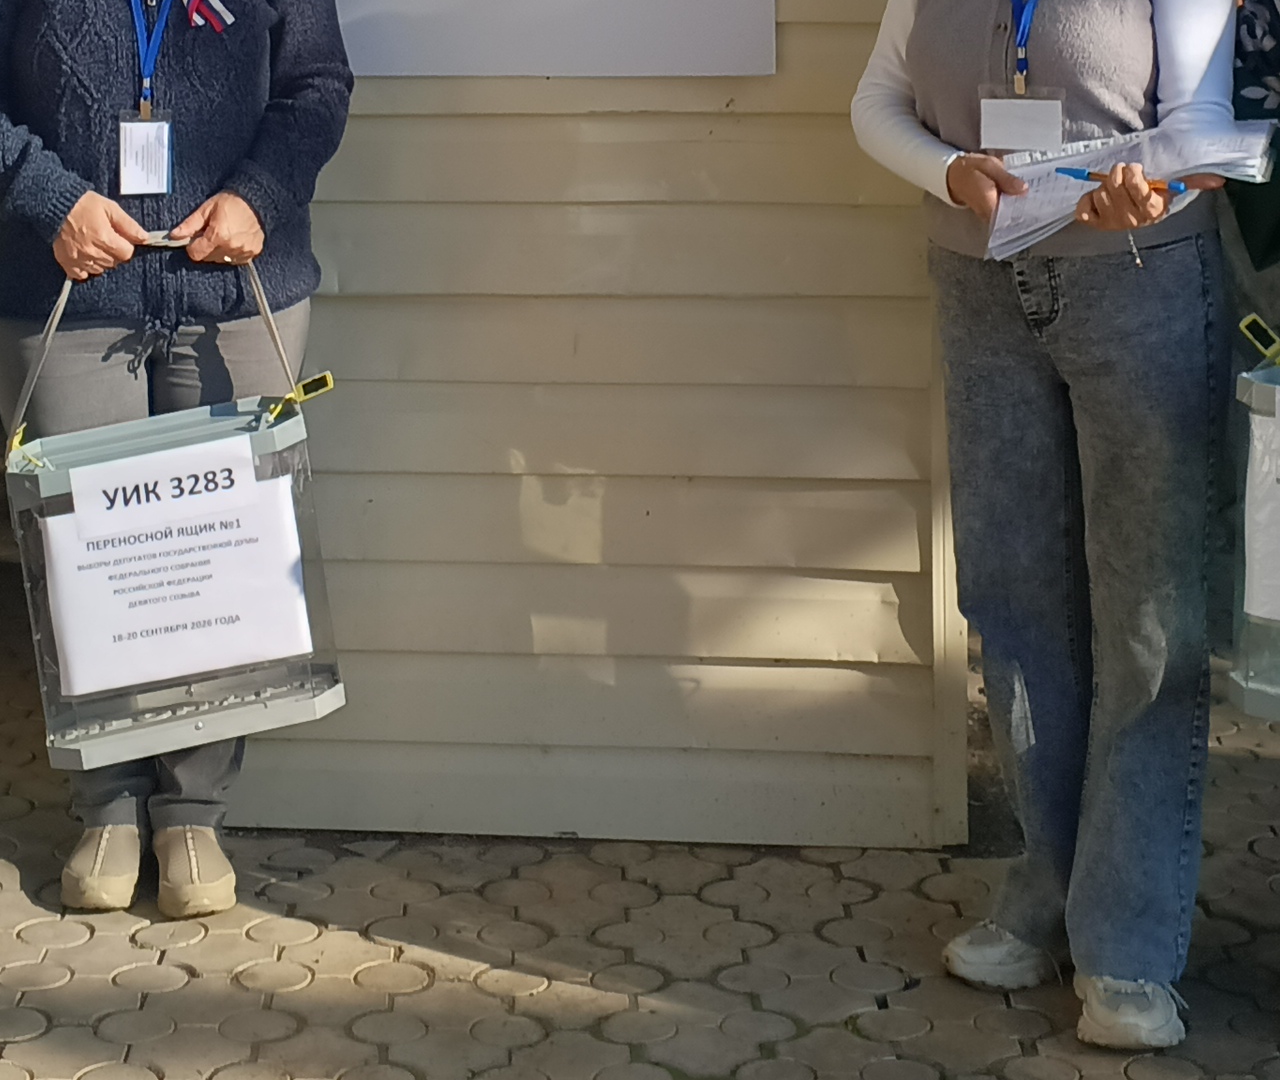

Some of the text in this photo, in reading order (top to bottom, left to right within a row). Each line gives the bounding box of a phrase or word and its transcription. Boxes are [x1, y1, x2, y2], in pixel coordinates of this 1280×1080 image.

[102, 467, 236, 511] УИК 3283
[86, 518, 241, 552] ПЕРЕНОСНОЙ ЯЩИК №1
[112, 553, 157, 567] ДЕПУТАТОВ
[112, 614, 241, 643] 18-20 СЕНТЯБРЯ 2026 ГОДА
